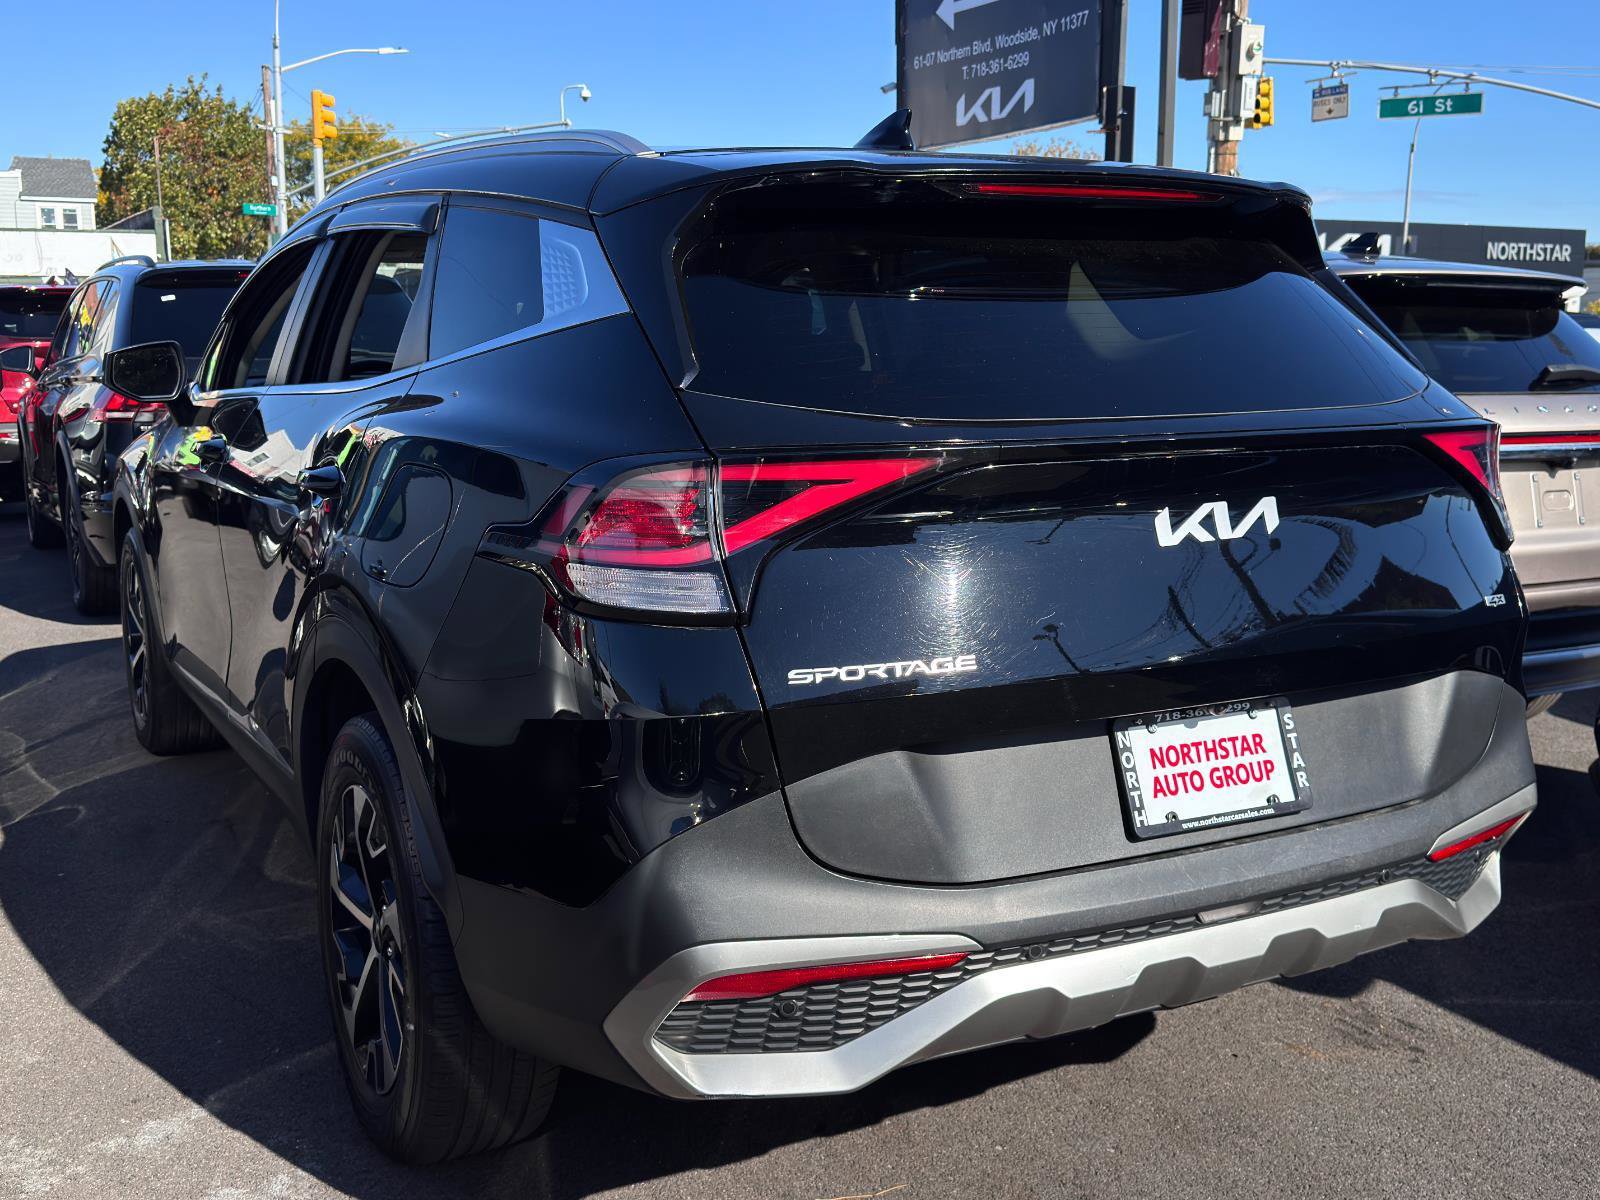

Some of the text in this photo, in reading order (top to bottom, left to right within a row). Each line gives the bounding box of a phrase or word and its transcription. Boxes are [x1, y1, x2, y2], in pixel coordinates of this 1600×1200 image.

[913, 51, 935, 70] 61-07
[936, 43, 971, 64] Northern
[995, 27, 1041, 49] Woodside,
[1042, 20, 1058, 37] NY
[1060, 9, 1089, 32] 11377
[971, 51, 1030, 78] 718-361-6299
[955, 77, 1036, 127] KIA
[1407, 98, 1453, 114] 61 St
[1486, 241, 1572, 263] NORTHSTAR
[1154, 496, 1280, 547] KIA
[787, 654, 978, 685] SPORTAGE
[1149, 733, 1267, 770] NORTHSTAR
[1153, 759, 1275, 799] AUTO GROUP
[1181, 807, 1275, 830] www.northstarcarsales.com
